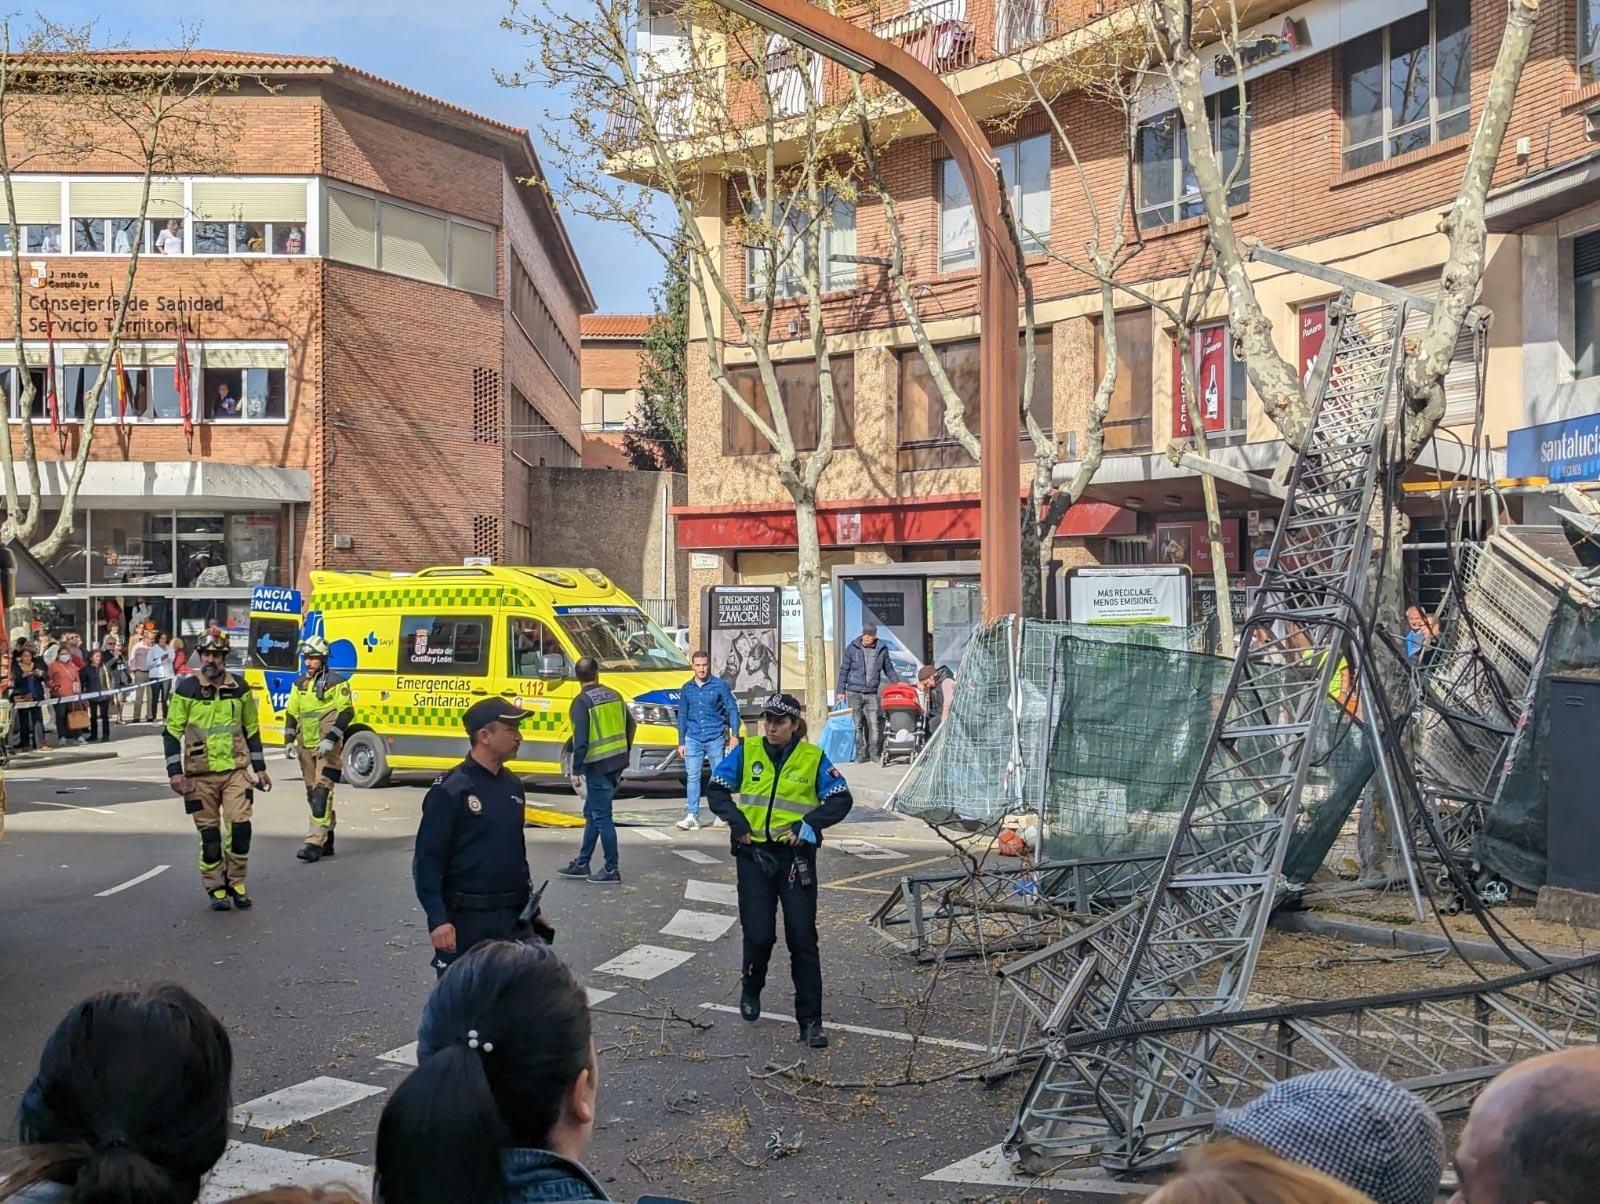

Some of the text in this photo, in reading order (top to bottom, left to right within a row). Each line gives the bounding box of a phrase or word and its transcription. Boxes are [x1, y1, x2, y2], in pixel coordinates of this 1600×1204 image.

[78, 271, 89, 279] de
[48, 280, 80, 289] Castilla
[29, 294, 224, 314] Consejería de Sanidad
[28, 317, 98, 333] Servicio
[1541, 424, 1600, 463] santalucí
[252, 588, 293, 601] ANCIA
[719, 595, 760, 604] ITINERARIOS
[1093, 598, 1119, 607] MENOS
[761, 595, 770, 625] 2023
[719, 611, 760, 623] ZAMORA
[426, 647, 444, 655] Junta
[410, 654, 431, 663] Castilla
[436, 655, 452, 663] León
[396, 676, 471, 693] Emergencias
[526, 680, 545, 696] 112
[413, 692, 471, 708] Sanitarias
